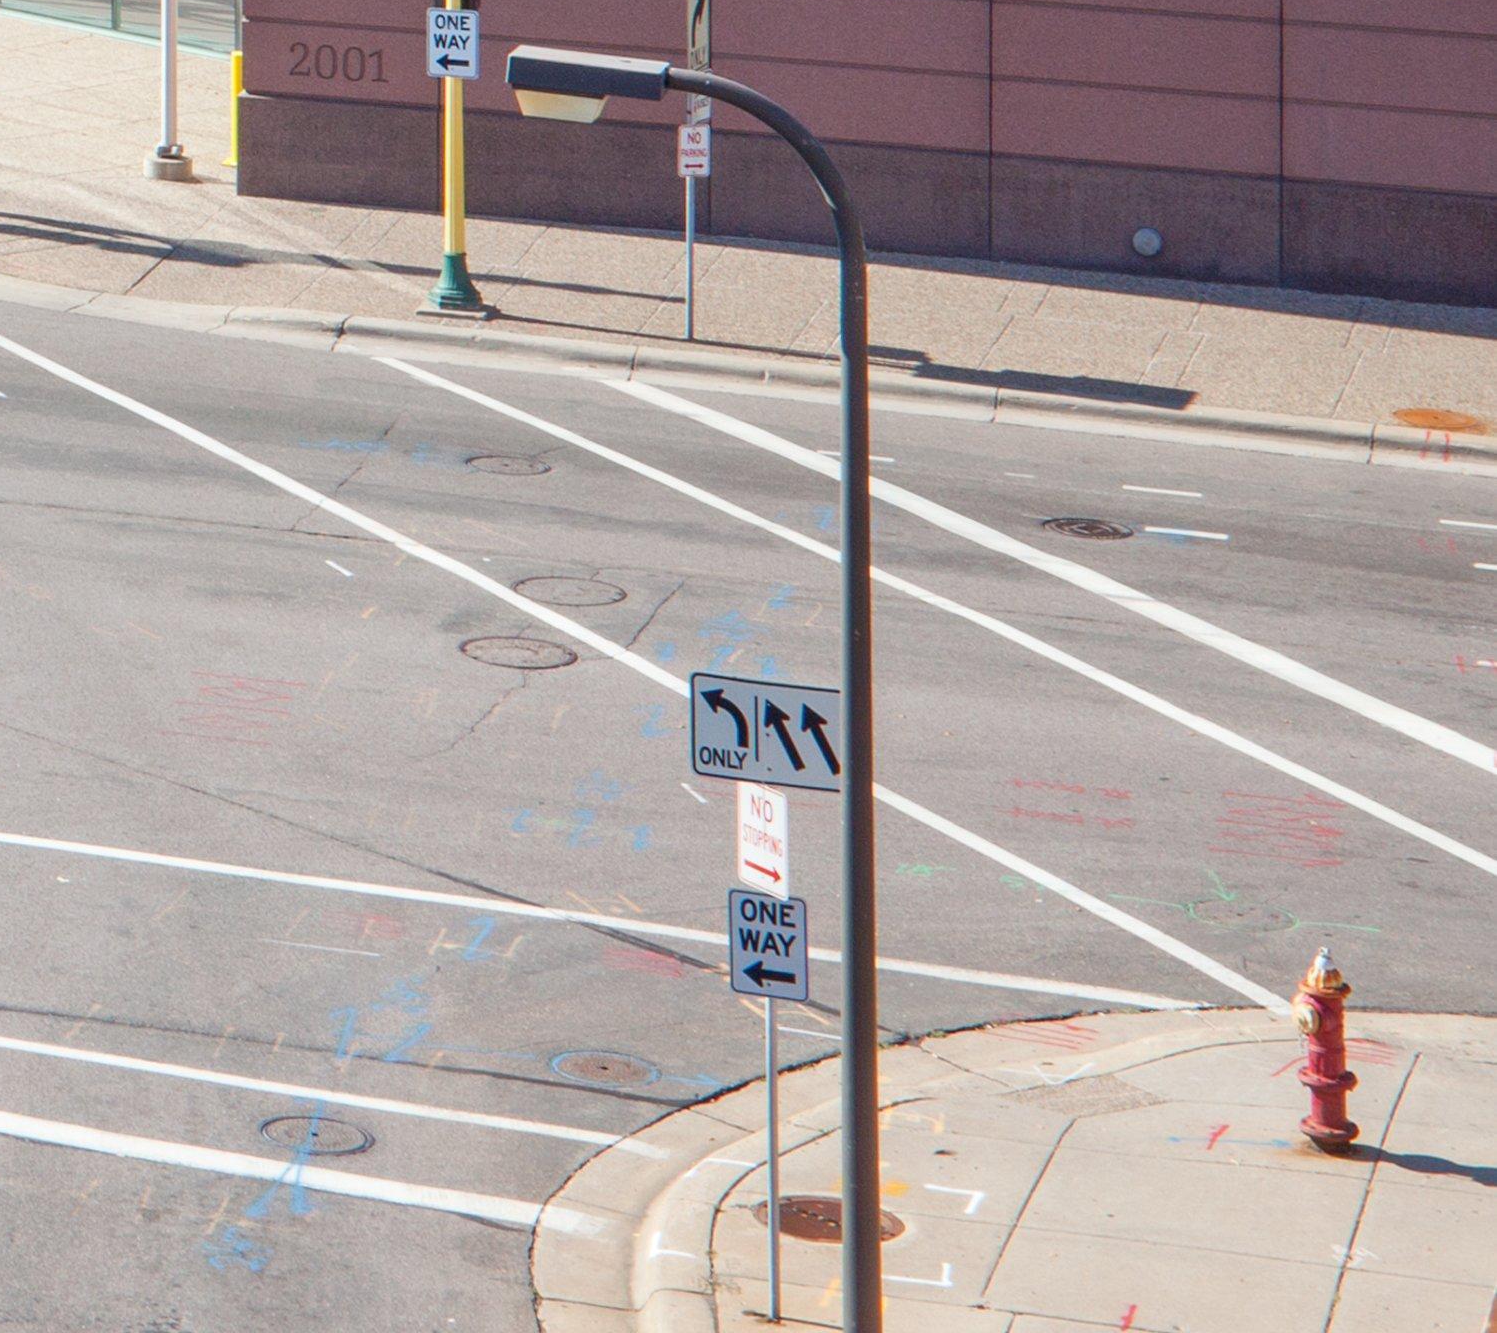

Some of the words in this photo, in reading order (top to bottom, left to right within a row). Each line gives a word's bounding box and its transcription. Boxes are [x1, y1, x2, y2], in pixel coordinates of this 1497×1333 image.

[434, 14, 471, 31] ONE
[433, 33, 471, 50] WAY
[289, 42, 389, 83] 2001
[687, 131, 702, 144] NO
[699, 746, 748, 770] ONLY
[750, 794, 773, 823] NO
[742, 823, 783, 858] STOPPING
[740, 899, 796, 928] ONE
[739, 928, 796, 958] WAY
